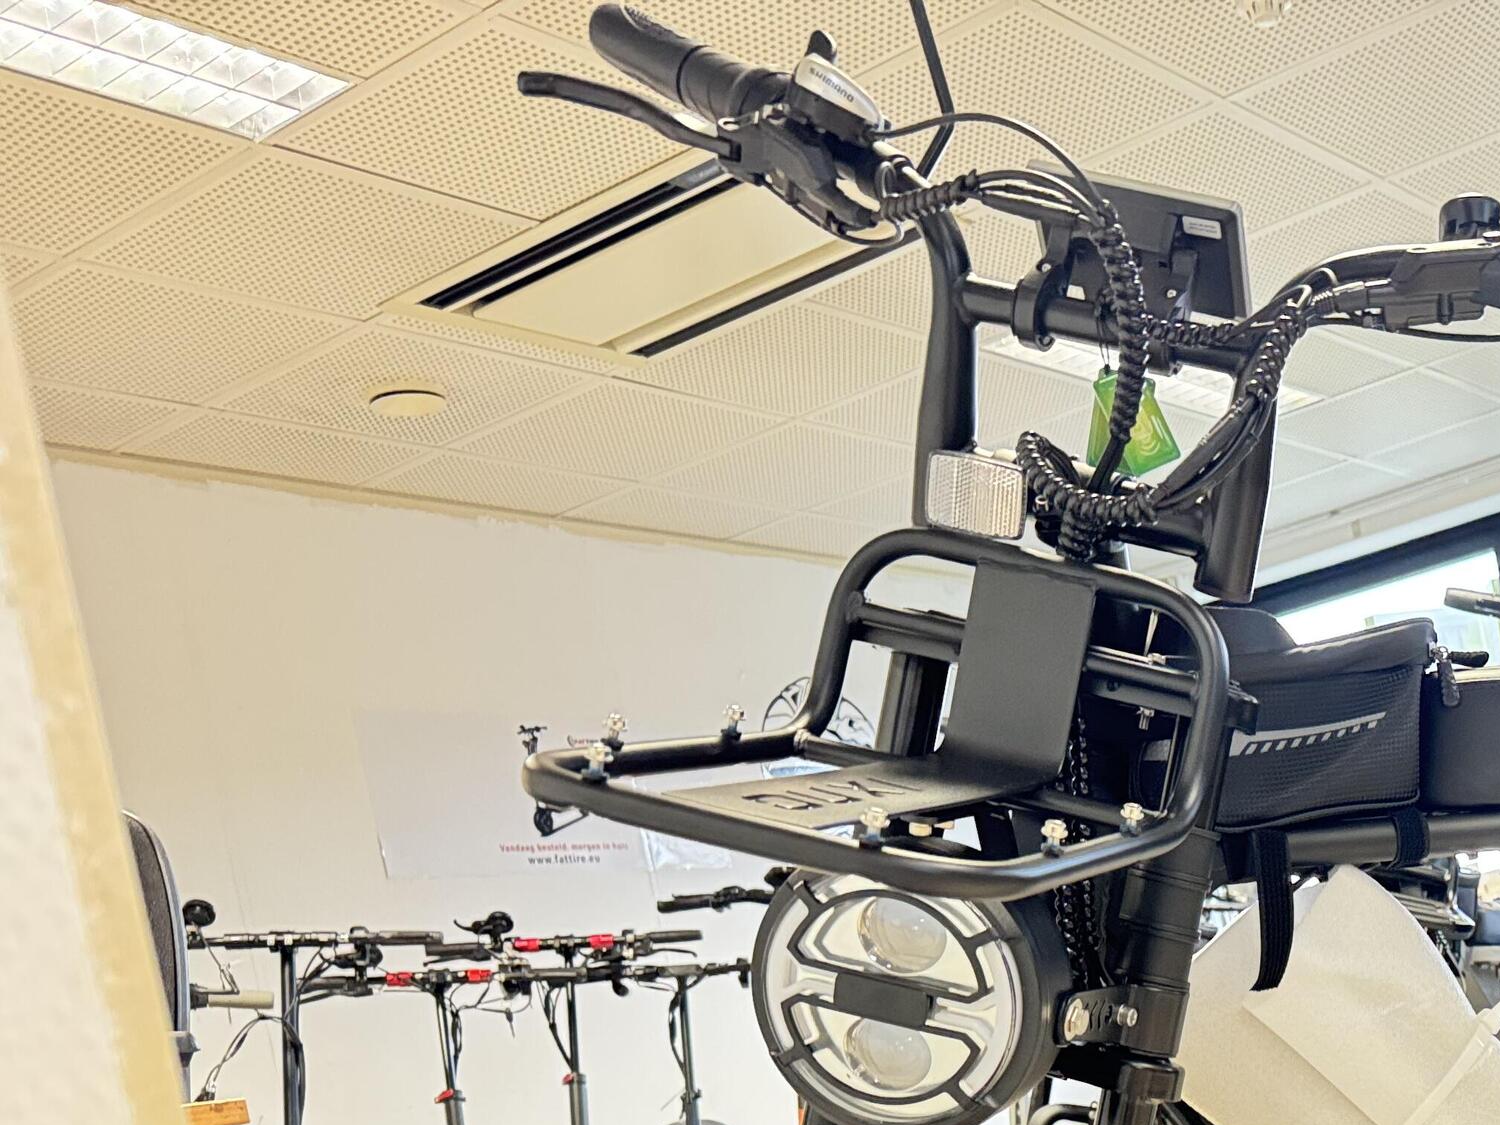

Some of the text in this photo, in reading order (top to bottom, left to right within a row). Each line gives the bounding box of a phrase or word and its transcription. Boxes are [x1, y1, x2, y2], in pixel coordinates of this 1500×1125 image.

[809, 67, 855, 103] SHIMANO
[571, 843, 600, 853] morgen
[528, 854, 601, 865] www.fattire.eu
